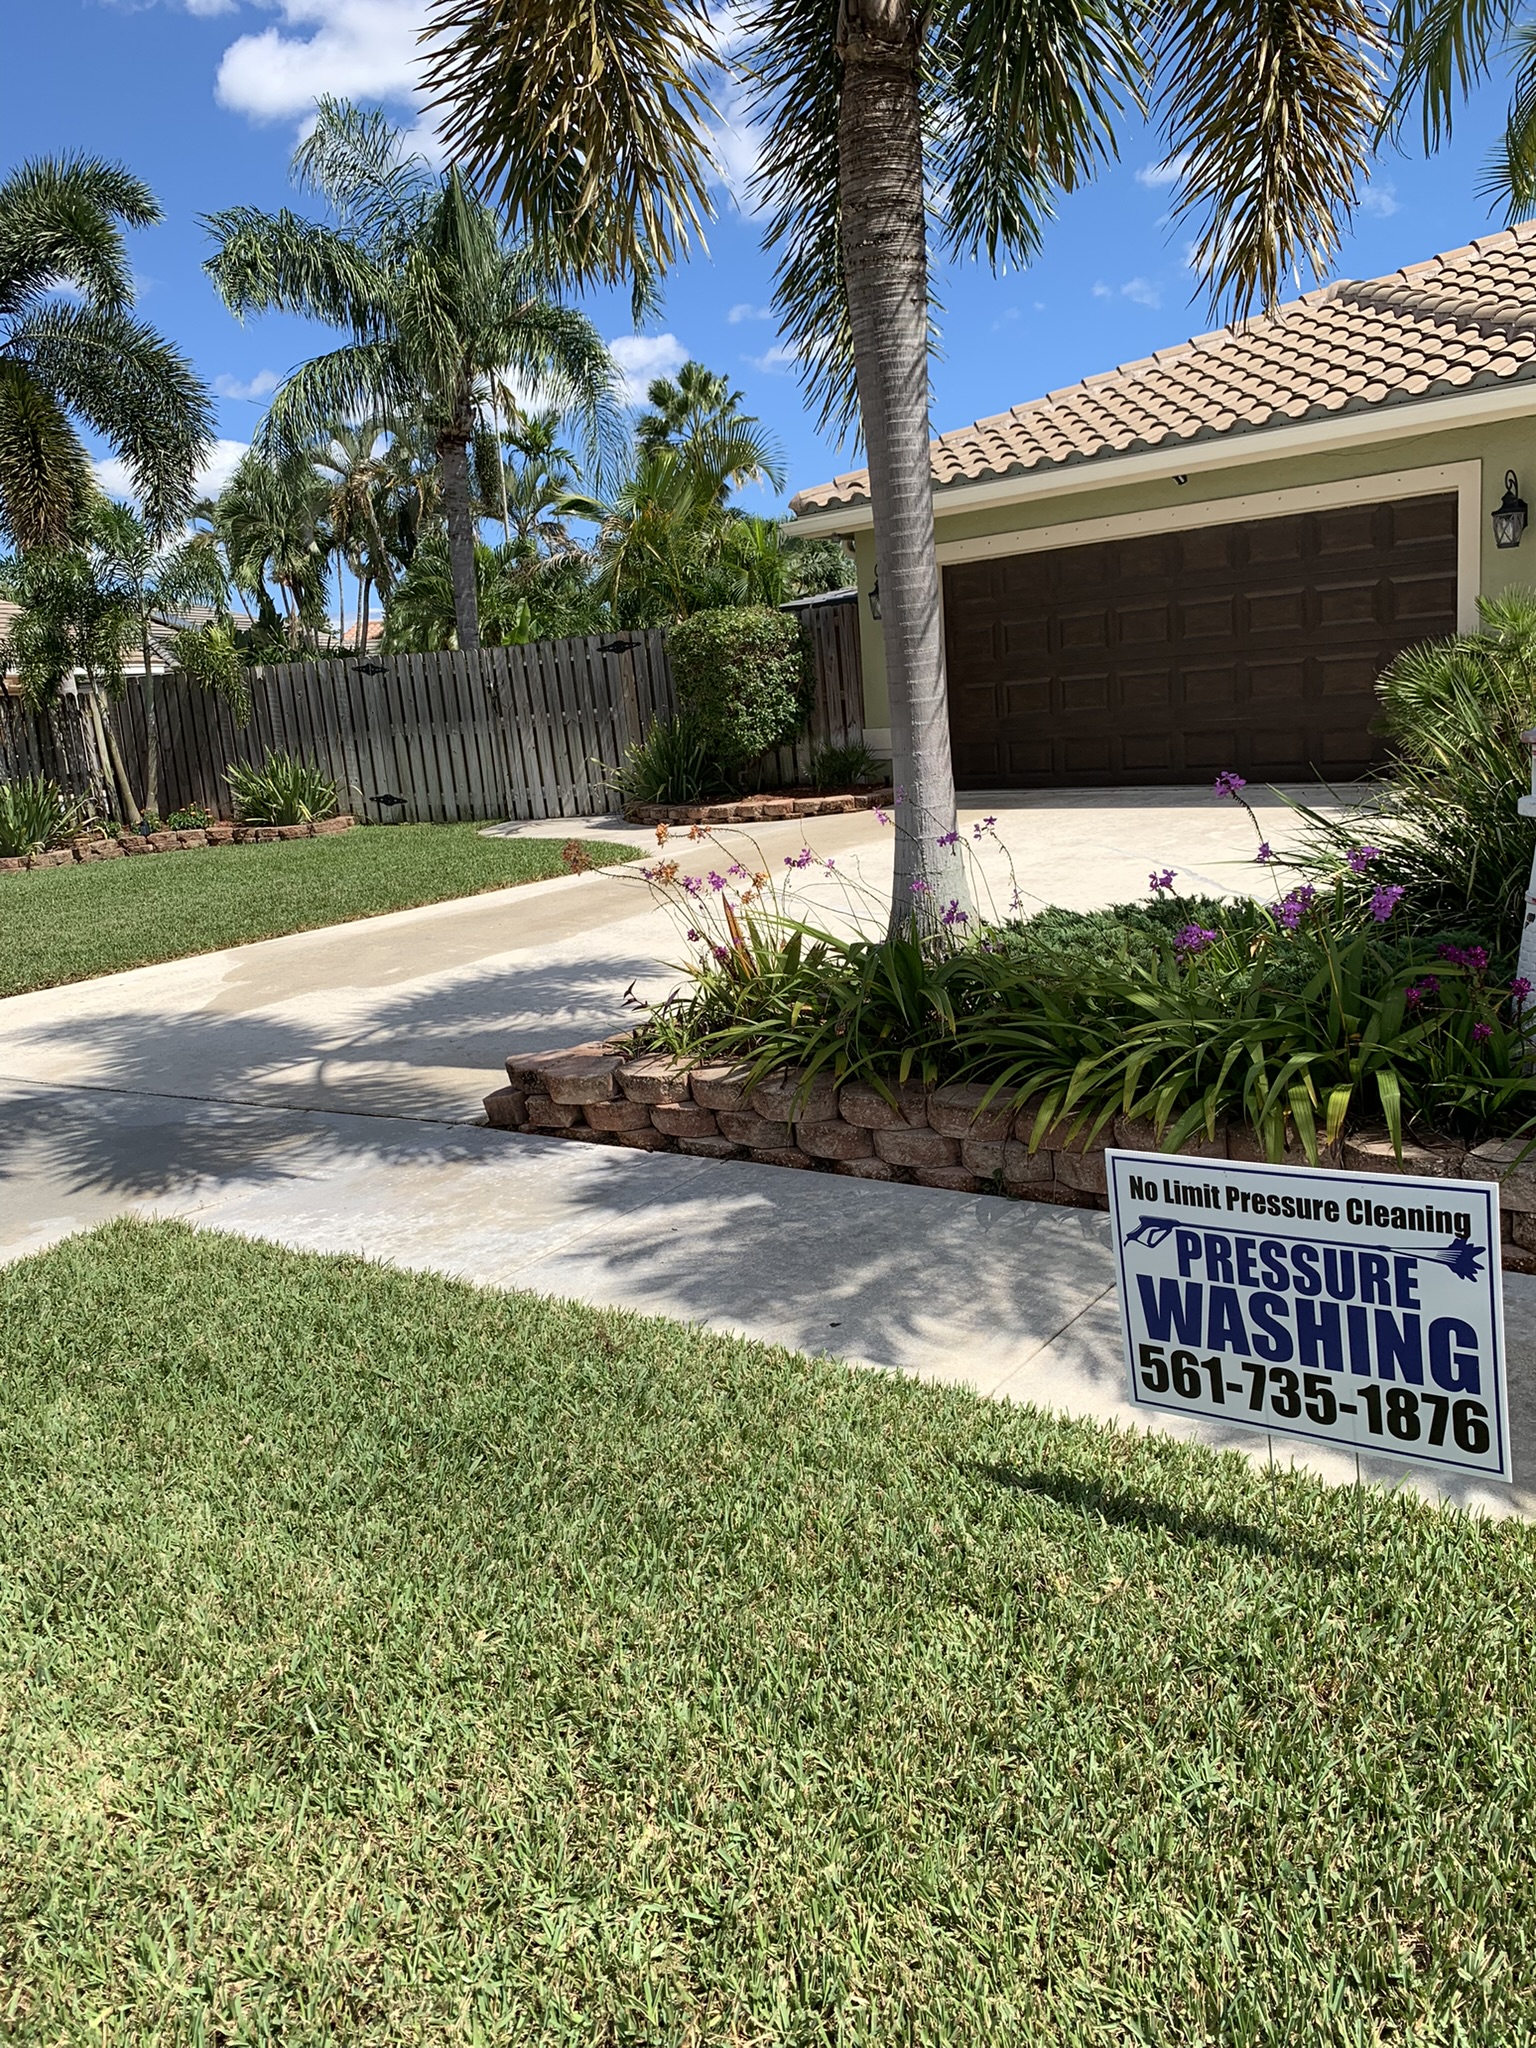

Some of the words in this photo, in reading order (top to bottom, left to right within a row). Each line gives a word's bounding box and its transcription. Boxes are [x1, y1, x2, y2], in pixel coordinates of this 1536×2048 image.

[1129, 1175, 1158, 1203] No
[1163, 1179, 1221, 1210] Limit
[1226, 1185, 1340, 1223] Pressure
[1346, 1197, 1471, 1239] Cleaning
[1175, 1229, 1421, 1311] PRESSURE
[1136, 1273, 1482, 1396] WASHING
[1138, 1343, 1490, 1455] 561-735-1876
